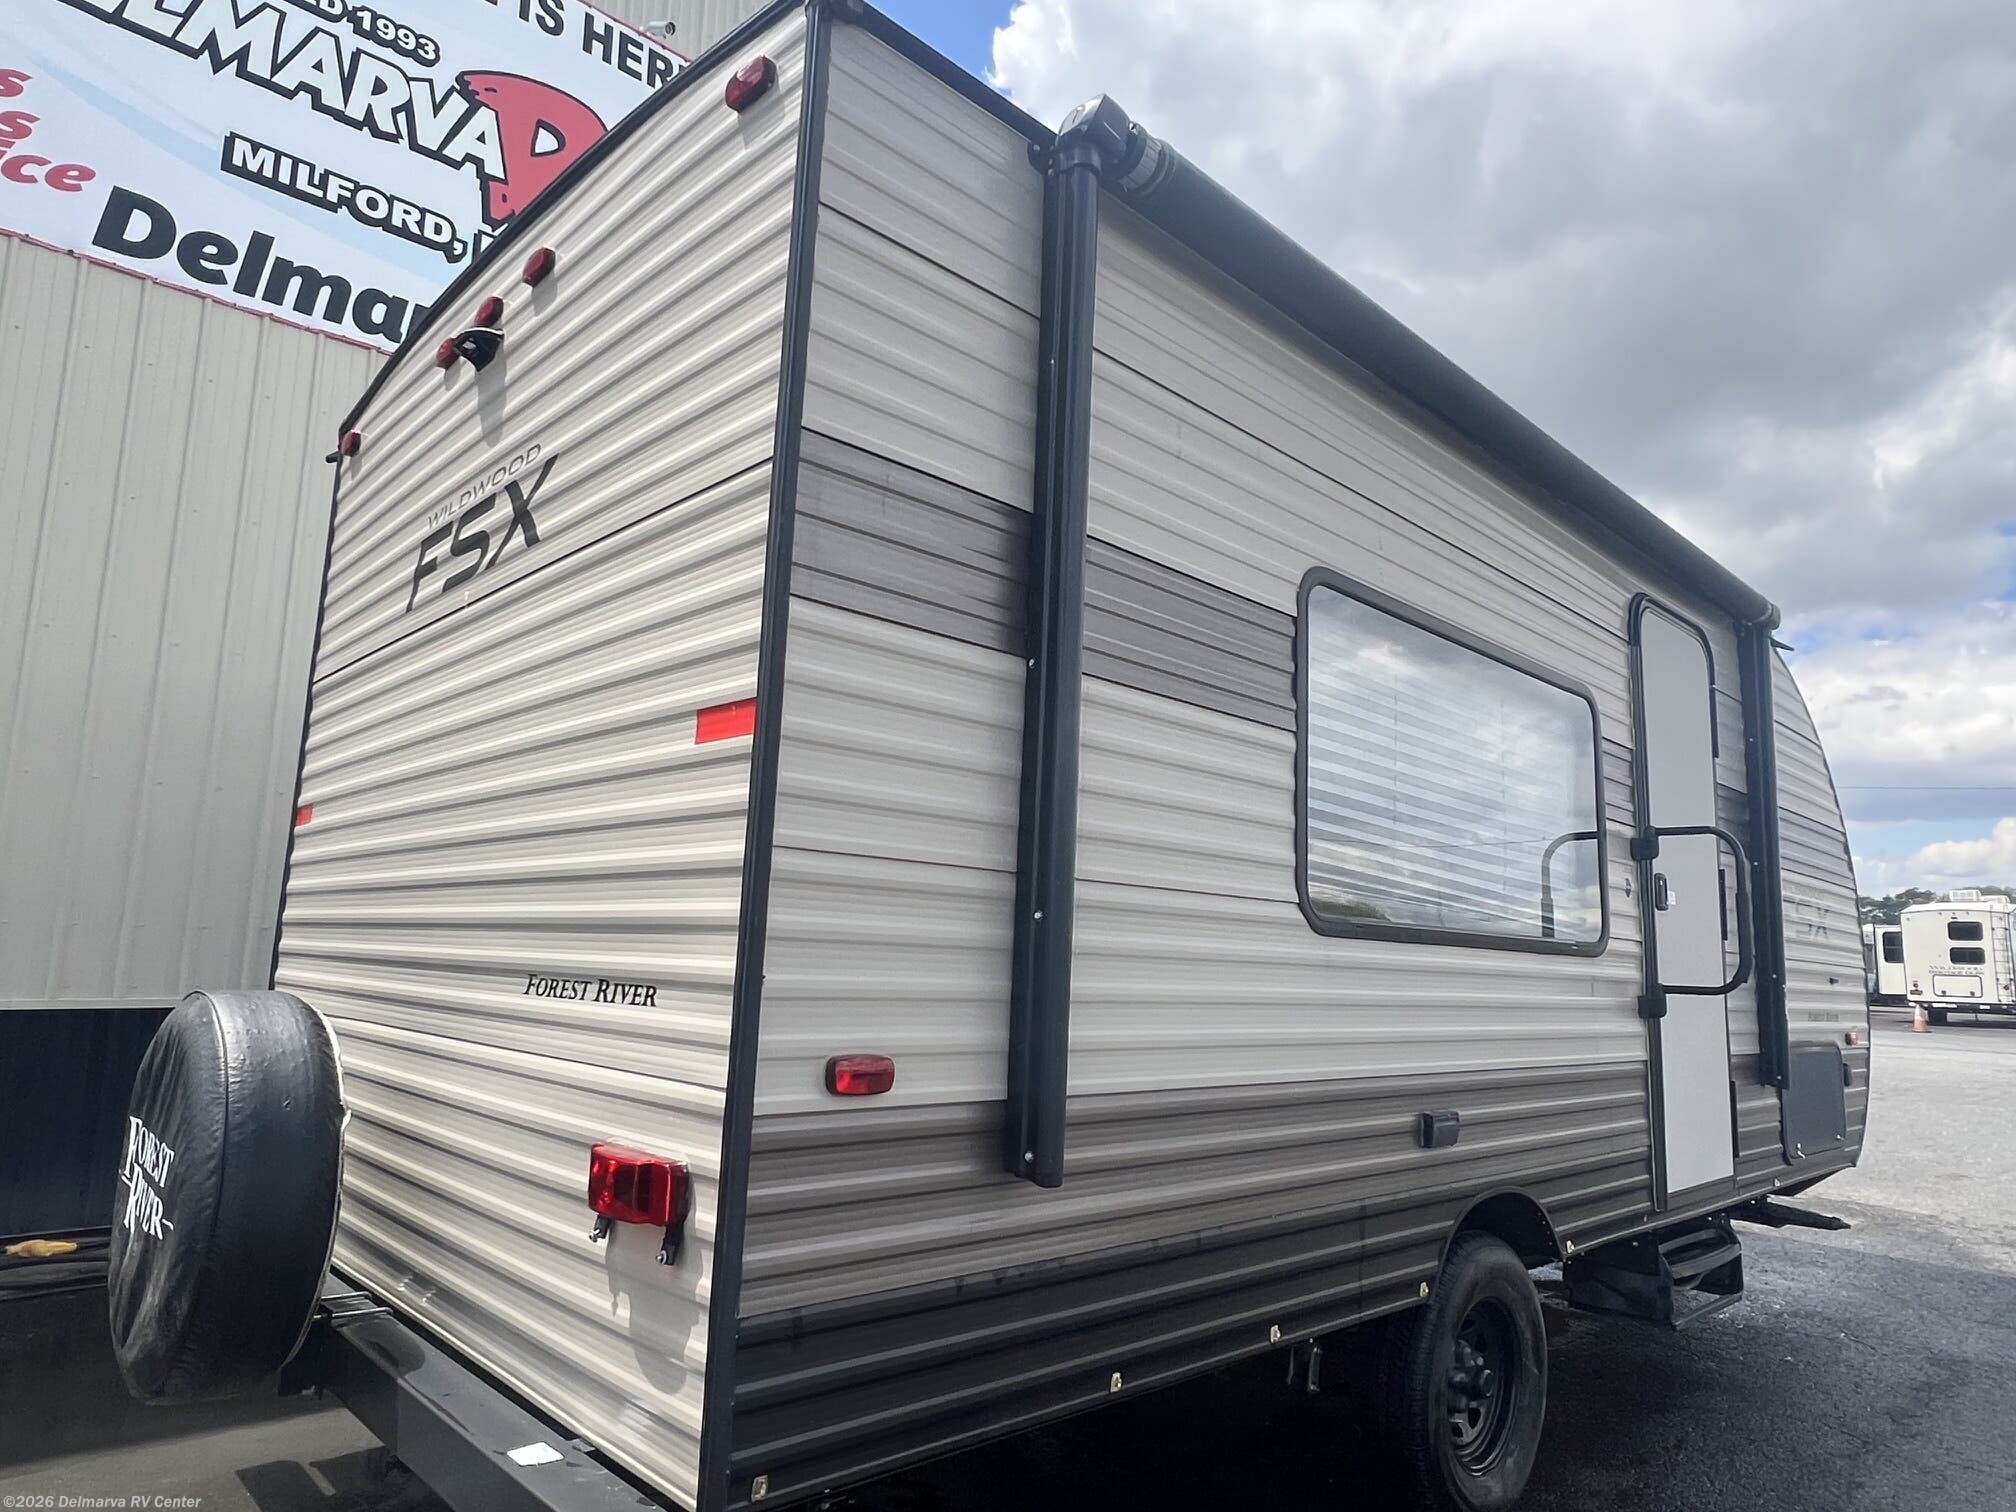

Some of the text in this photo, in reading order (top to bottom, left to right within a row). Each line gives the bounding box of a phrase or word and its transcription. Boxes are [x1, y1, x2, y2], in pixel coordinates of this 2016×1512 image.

[355, 8, 438, 63] 1993
[582, 12, 688, 88] HER
[225, 134, 465, 258] MILFORD,
[428, 443, 542, 529] WILDWOOD
[405, 452, 560, 613] FSX
[522, 973, 657, 1007] FOREST RIVER
[123, 1115, 175, 1188] FOREST
[120, 1162, 172, 1240] RIVER
